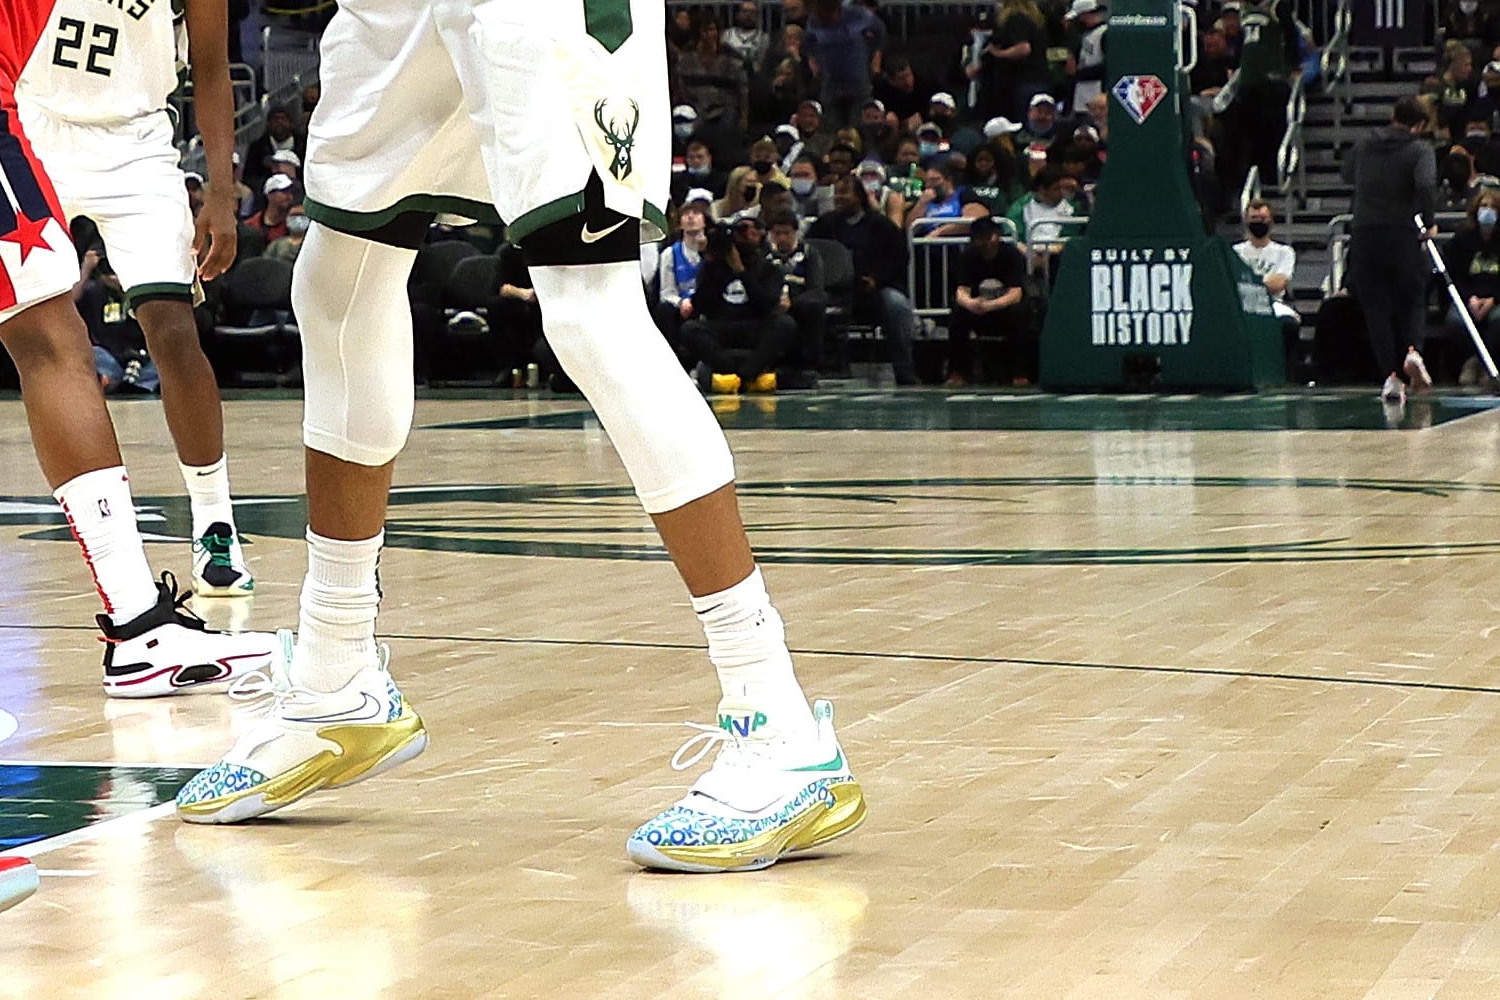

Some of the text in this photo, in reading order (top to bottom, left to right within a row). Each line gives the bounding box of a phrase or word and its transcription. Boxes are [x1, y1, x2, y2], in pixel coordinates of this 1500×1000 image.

[52, 16, 119, 77] 22
[1091, 248, 1190, 261] BUILT BY
[1091, 263, 1194, 312] BLACK
[1091, 312, 1193, 345] HISTORY
[718, 711, 768, 738] MVP
